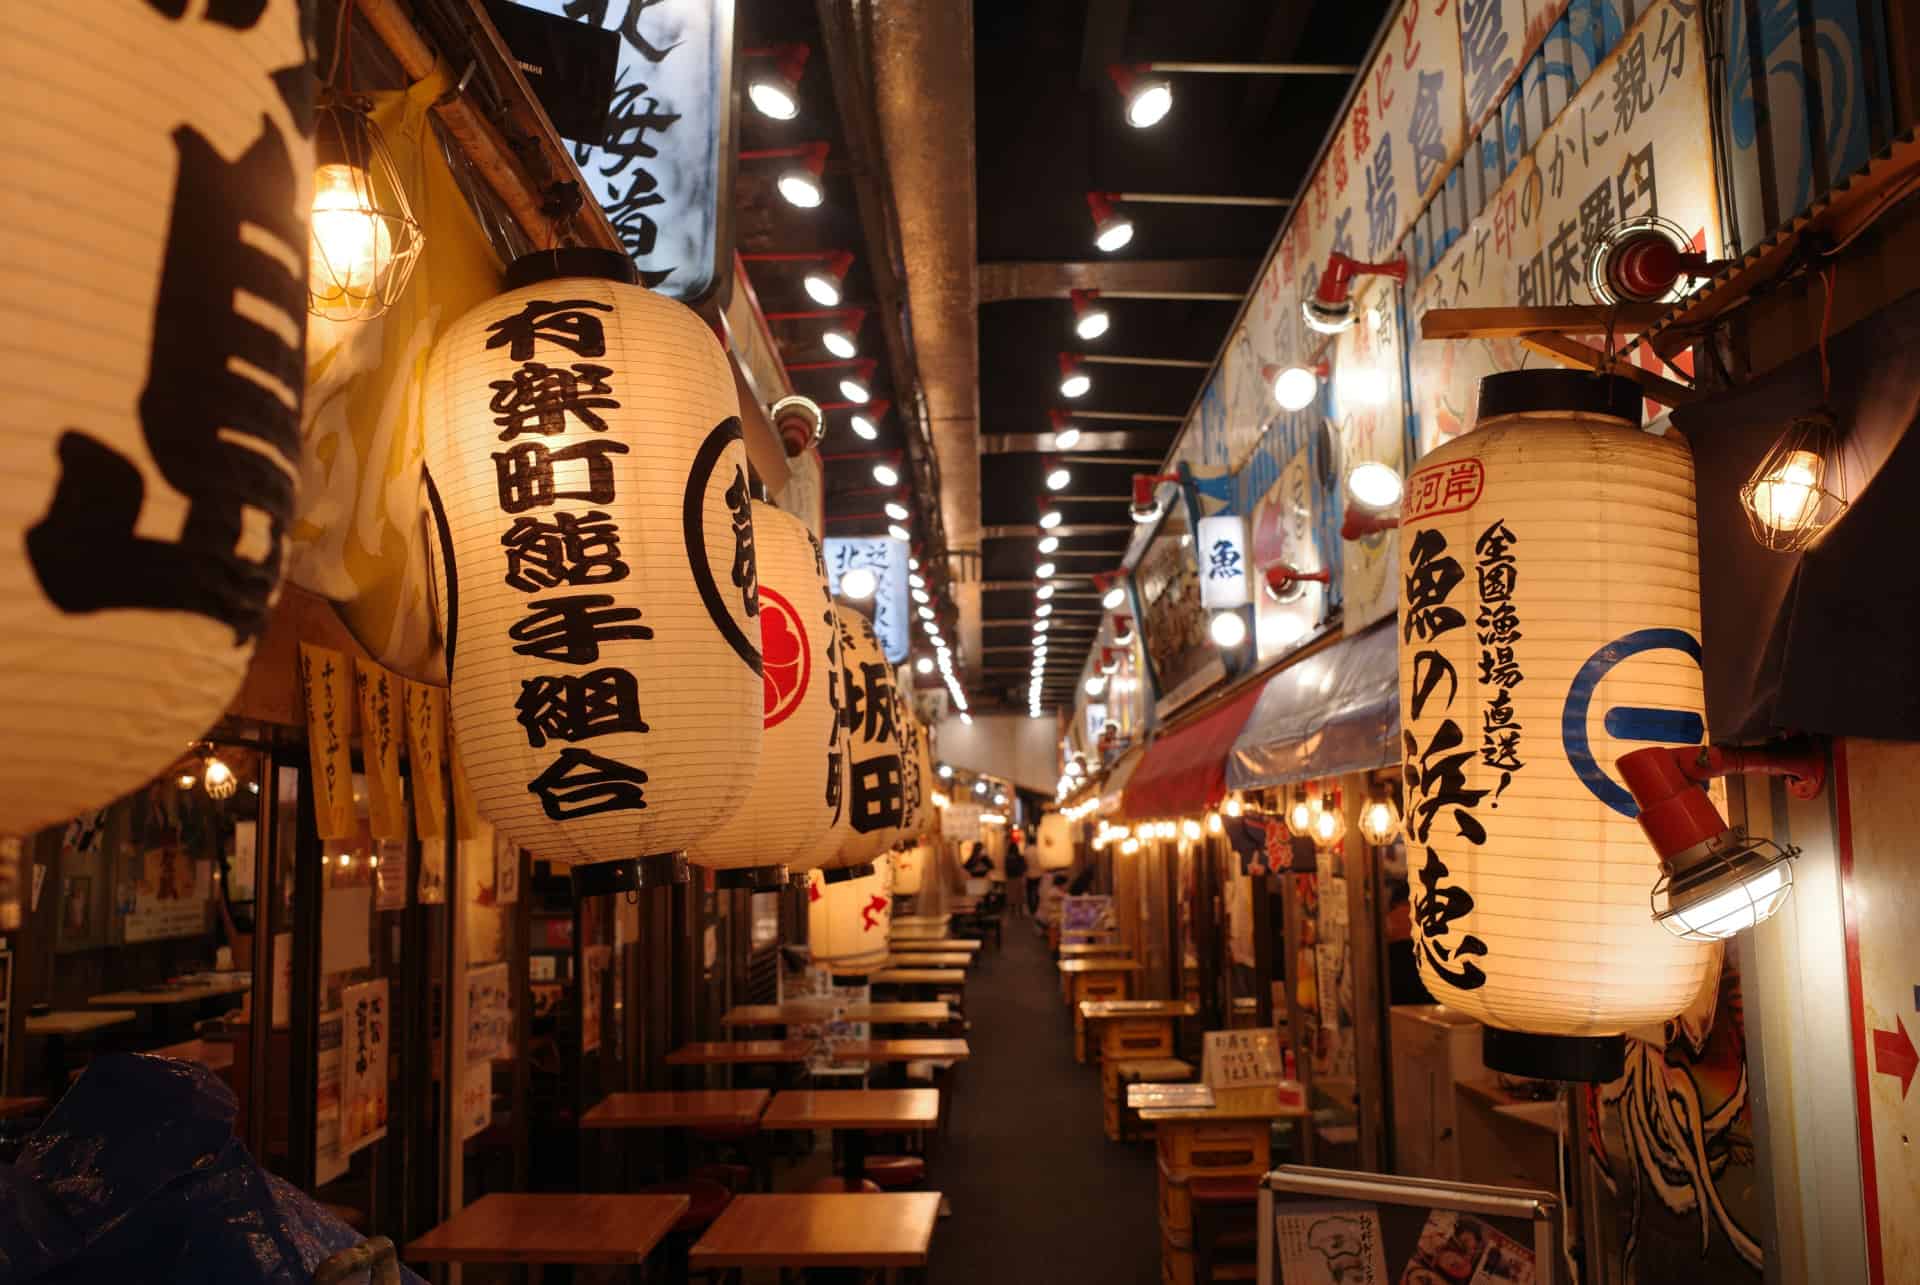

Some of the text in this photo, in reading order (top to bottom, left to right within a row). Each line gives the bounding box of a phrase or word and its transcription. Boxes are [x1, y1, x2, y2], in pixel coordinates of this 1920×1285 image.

[1415, 8, 1686, 315] ネスケ印のかに親分
[1403, 463, 1478, 514] 河岸
[1208, 539, 1243, 581] 魚
